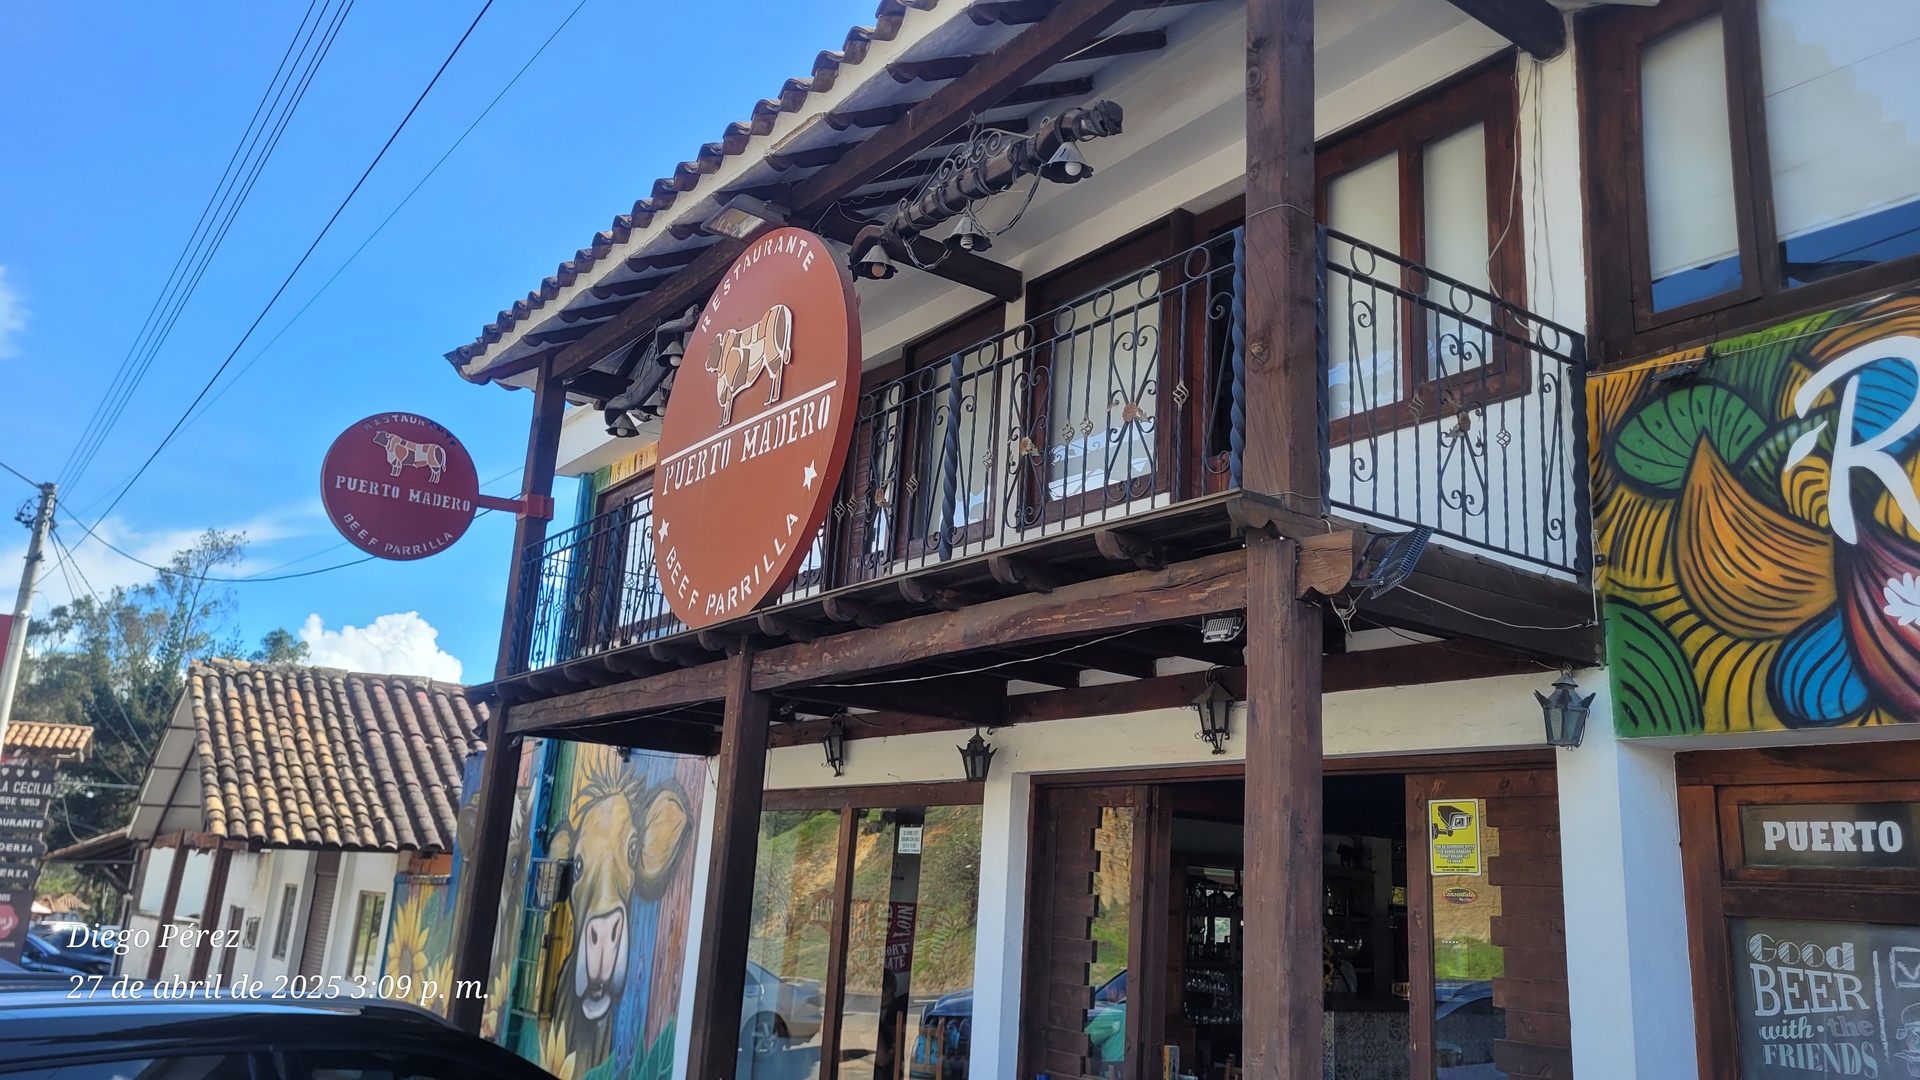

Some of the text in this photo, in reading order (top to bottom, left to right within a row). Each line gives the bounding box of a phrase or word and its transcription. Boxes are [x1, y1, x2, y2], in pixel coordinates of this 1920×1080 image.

[701, 235, 816, 334] RESTAURANTE
[363, 414, 457, 447] RESTAURANTE
[662, 394, 832, 496] PUERTO MADERO
[335, 475, 471, 512] PUERTO MADERO
[343, 512, 453, 555] BEEF PARRILLA
[665, 512, 799, 617] BEEF PARRILLA
[13, 781, 52, 796] CECILIA
[1762, 820, 1903, 853] PUERTO
[1746, 932, 1855, 972] Good
[1750, 963, 1869, 1017] BEER
[1759, 1015, 1874, 1040] with the
[1762, 1041, 1878, 1079] FRIENDS
